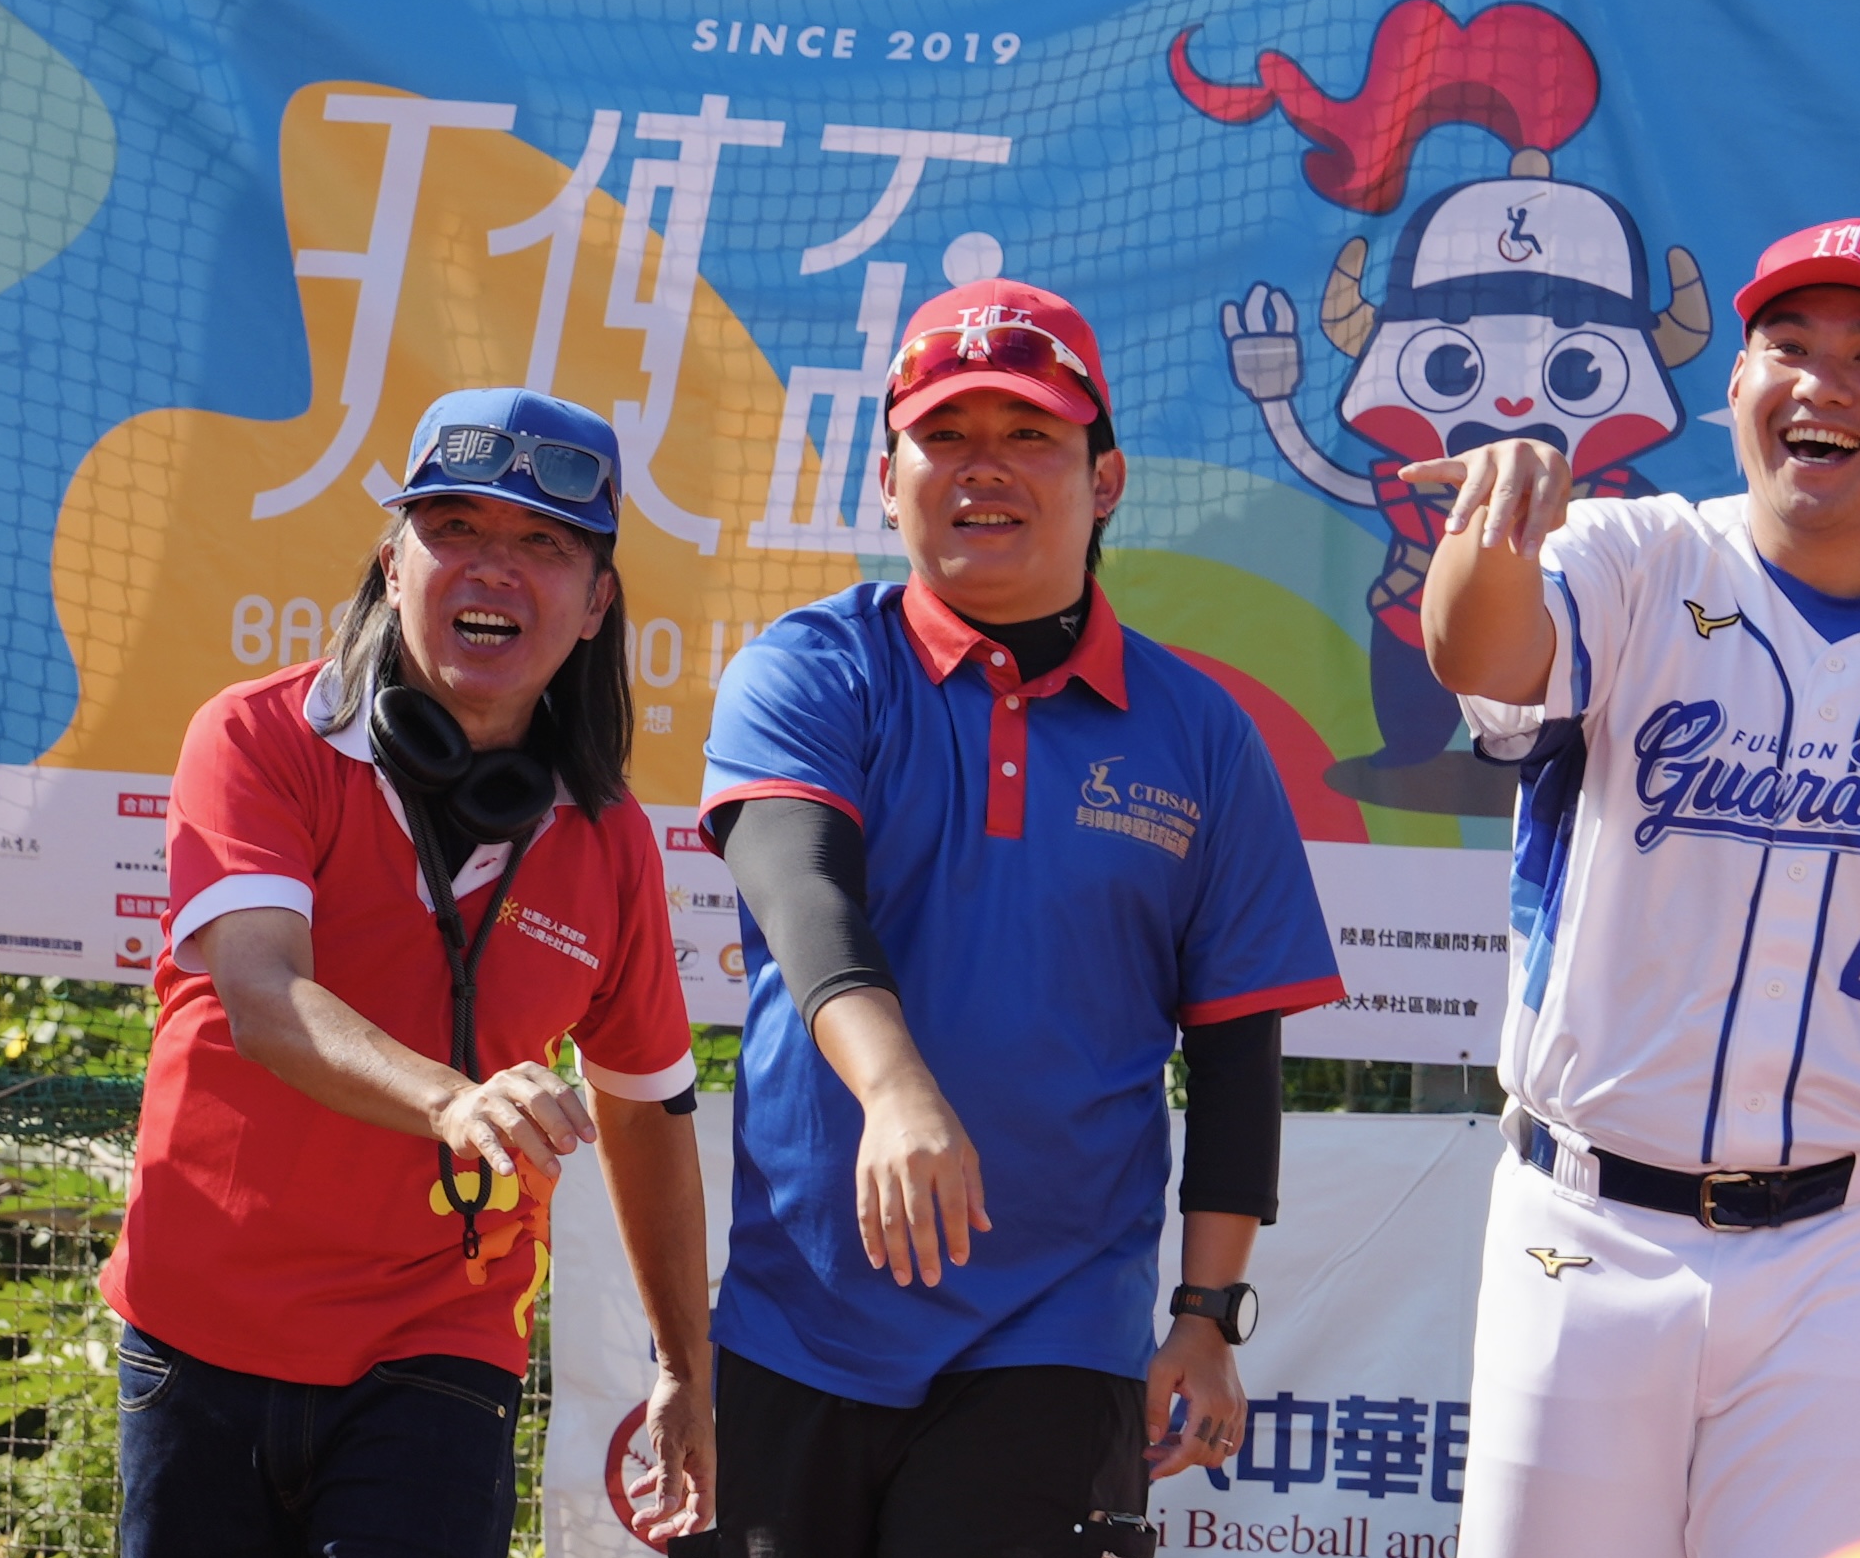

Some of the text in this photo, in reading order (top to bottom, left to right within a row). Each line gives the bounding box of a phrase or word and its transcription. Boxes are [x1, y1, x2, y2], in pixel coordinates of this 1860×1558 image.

[692, 18, 1024, 66] SINCE 2019
[642, 705, 673, 735] 想
[1322, 993, 1480, 1018] 央大學社區聯誼會
[1185, 1508, 1370, 1558] Baseball
